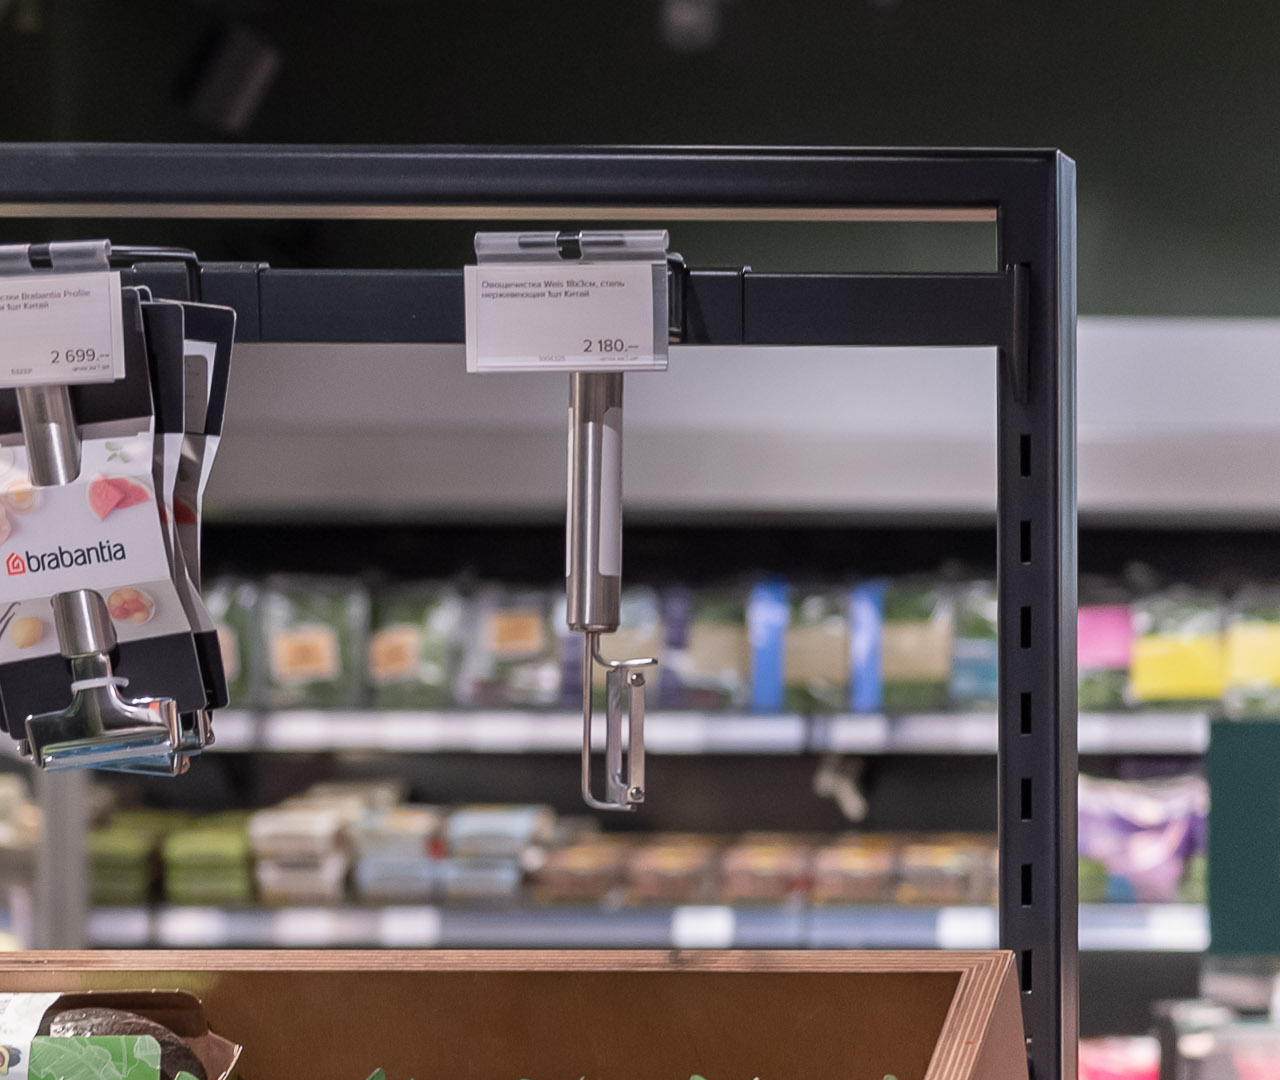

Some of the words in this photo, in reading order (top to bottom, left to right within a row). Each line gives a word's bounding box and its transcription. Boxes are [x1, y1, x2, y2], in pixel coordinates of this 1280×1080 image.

[582, 338, 593, 353] 2
[50, 349, 60, 364] 2
[25, 540, 126, 573] brabantia
